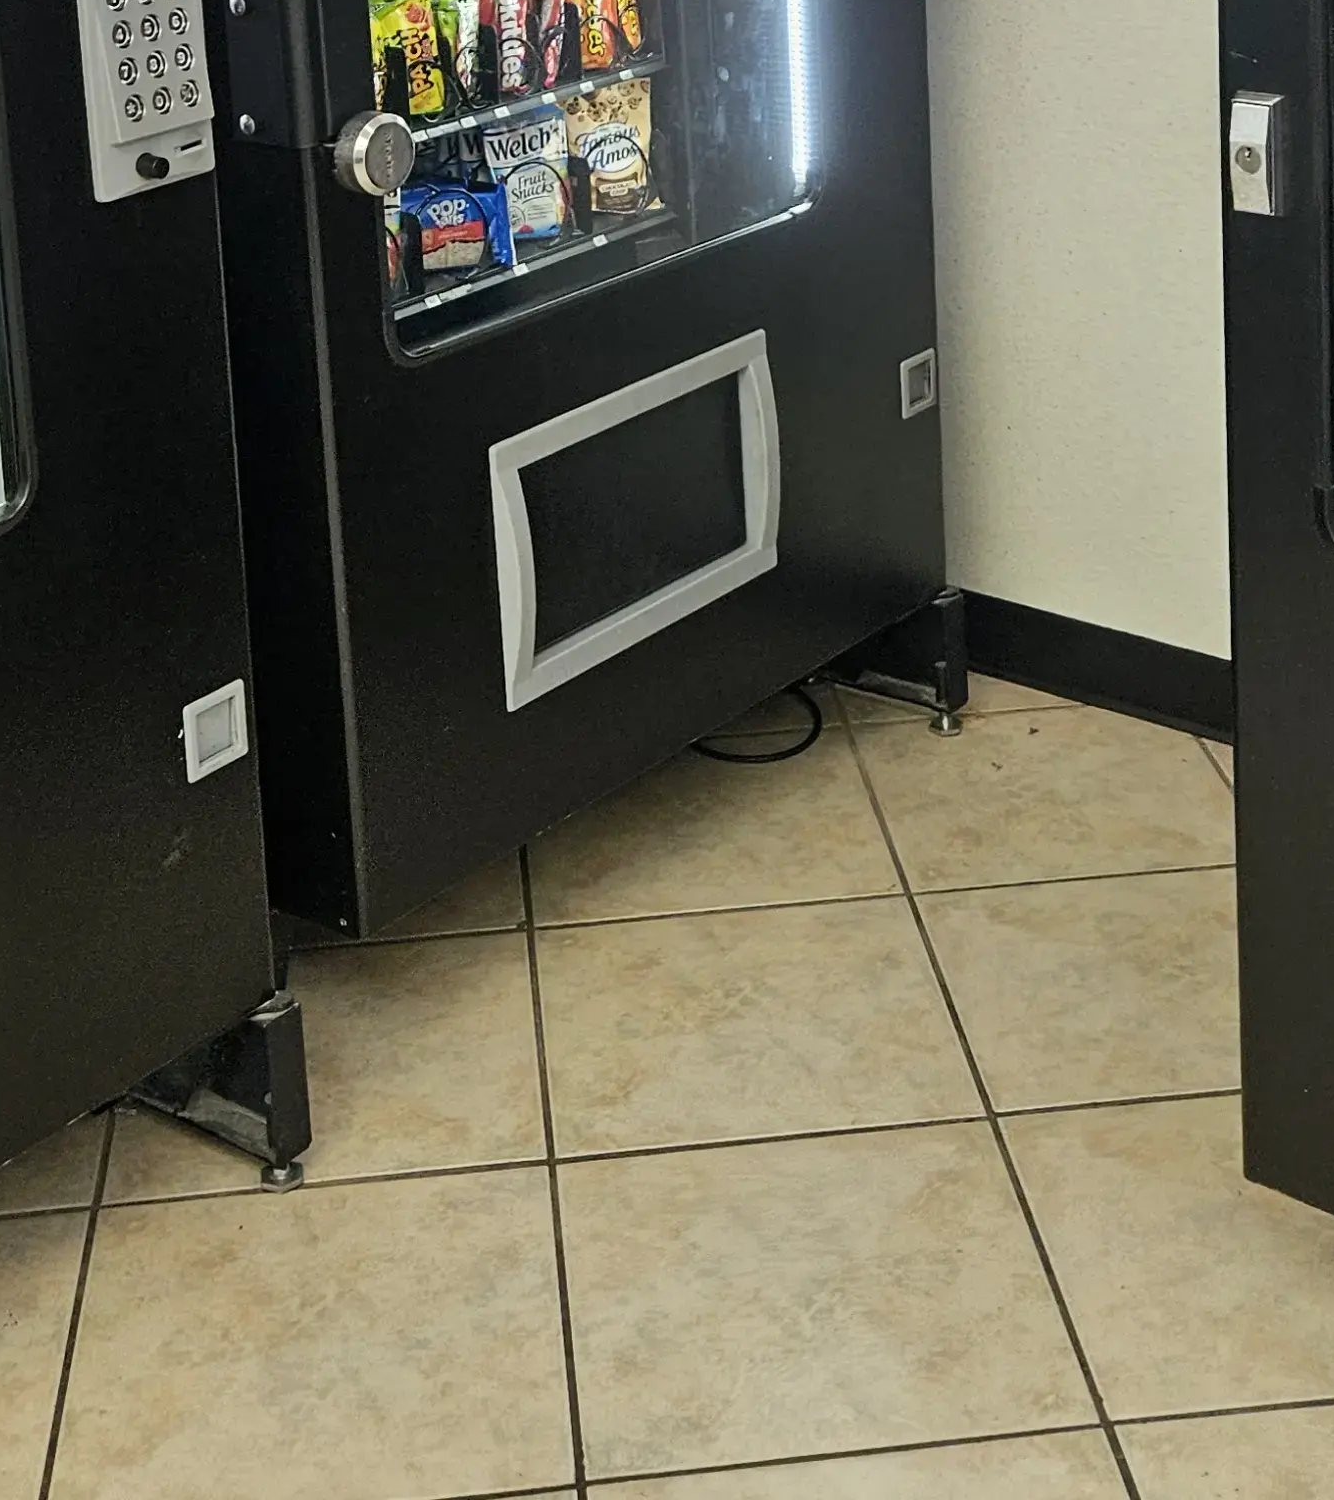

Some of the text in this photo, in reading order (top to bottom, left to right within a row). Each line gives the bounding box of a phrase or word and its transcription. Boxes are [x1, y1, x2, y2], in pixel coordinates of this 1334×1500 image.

[487, 126, 560, 162] Welch's
[576, 128, 641, 153] Famous
[591, 145, 638, 171] Amos
[510, 181, 557, 203] Snacks
[517, 172, 548, 190] Fruit
